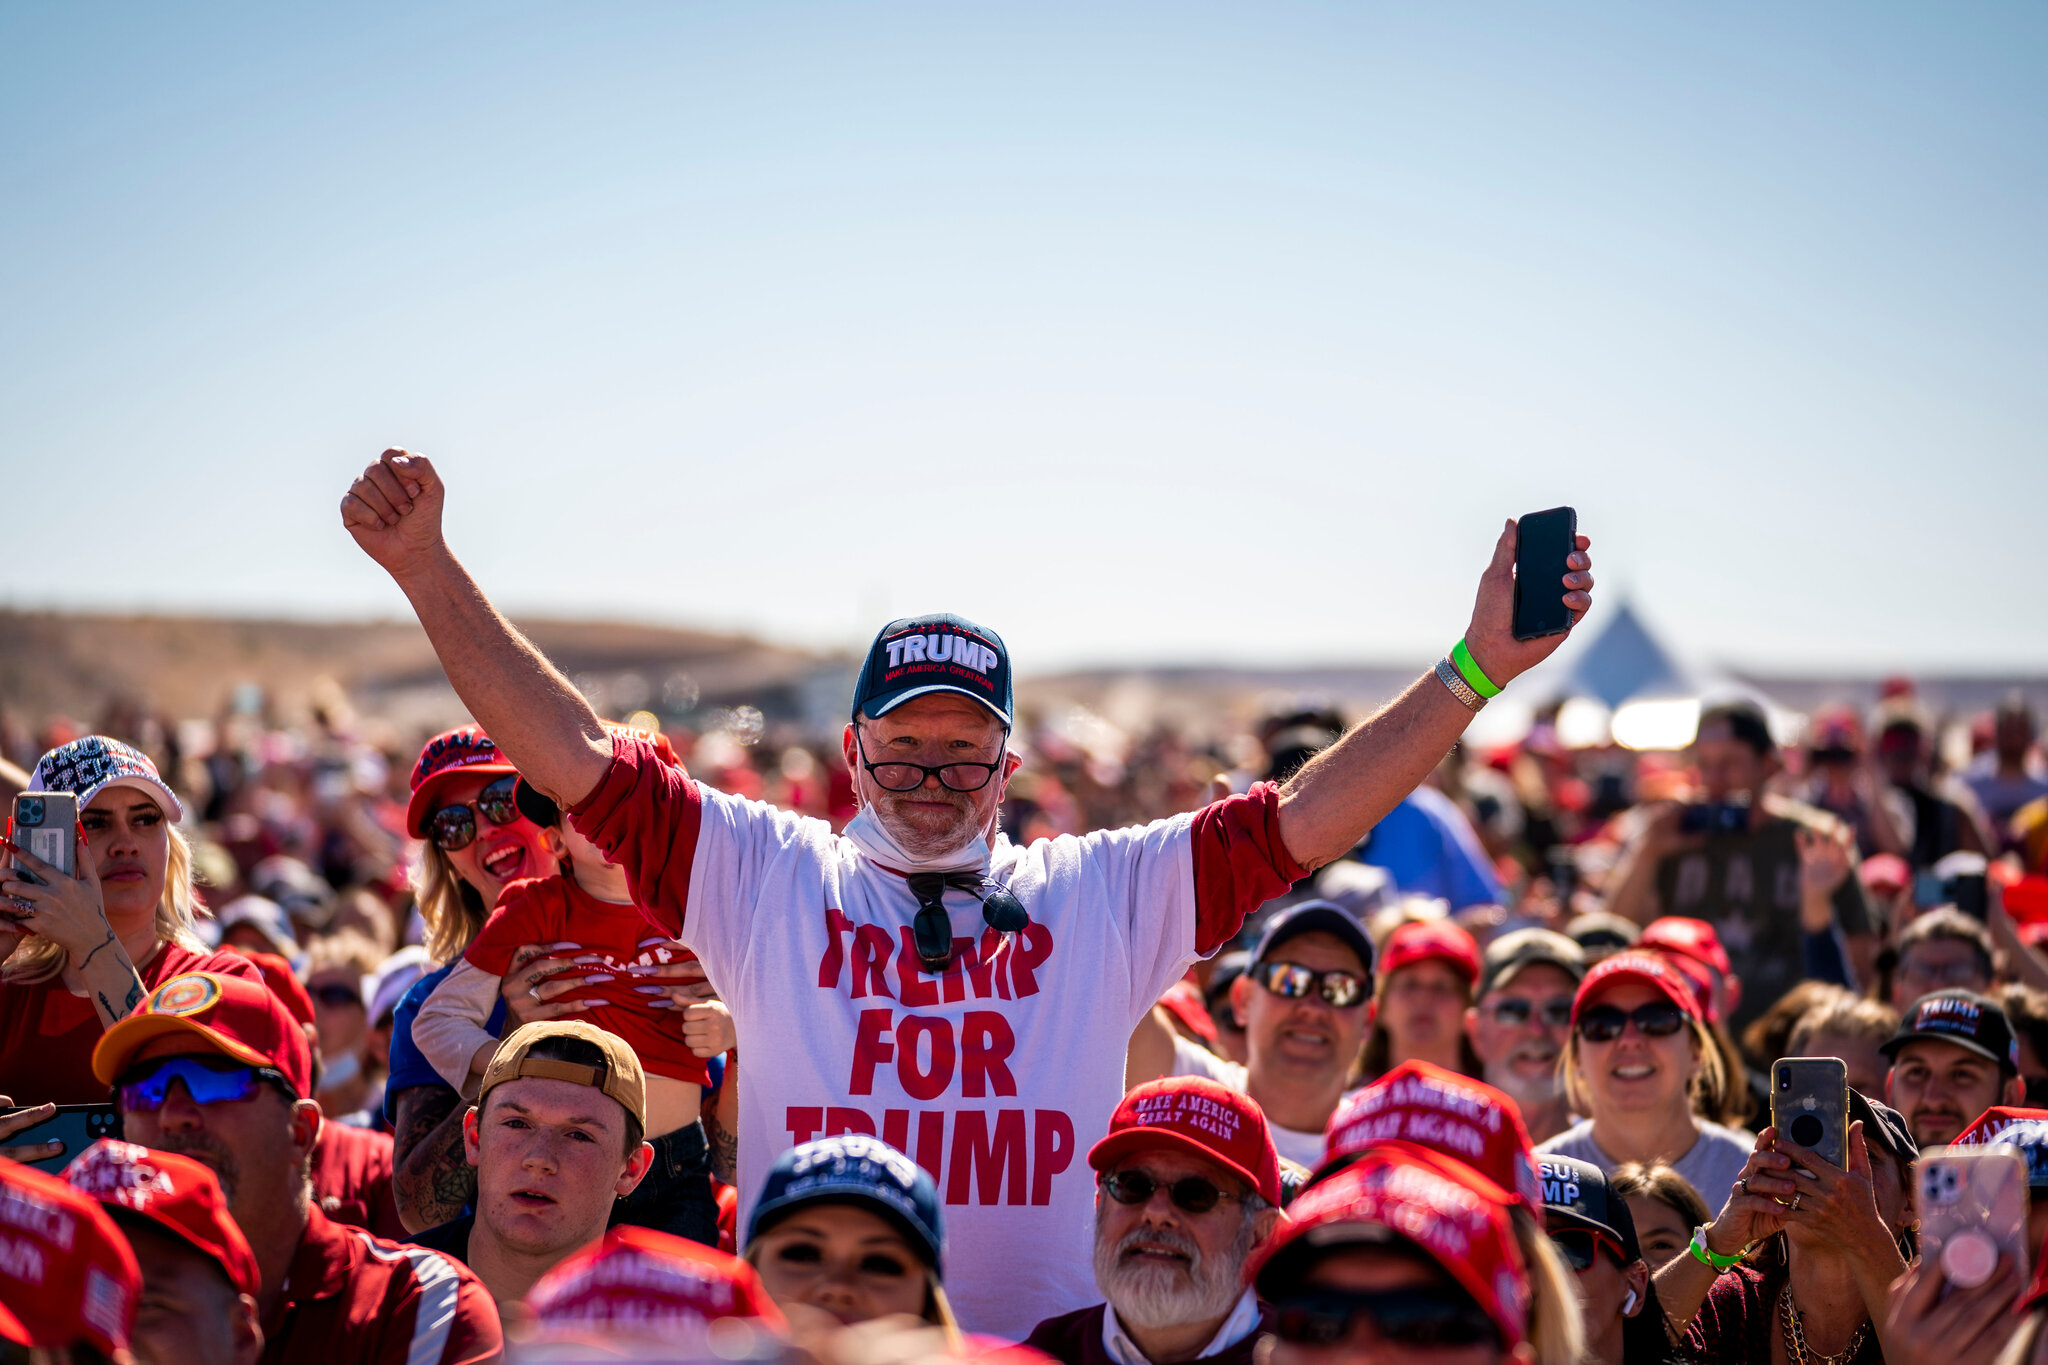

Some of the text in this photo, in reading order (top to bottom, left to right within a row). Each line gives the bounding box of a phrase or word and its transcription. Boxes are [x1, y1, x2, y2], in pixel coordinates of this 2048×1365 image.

[886, 633, 998, 675] TRUMP
[885, 667, 906, 683] MAKE
[906, 664, 947, 675] AMERICA
[949, 665, 976, 680] GREAT
[1921, 998, 1980, 1019] TRUMP
[849, 1009, 1017, 1101] FOR
[1135, 1092, 1240, 1130] MAKE AMERICA
[1137, 1111, 1232, 1141] GREAT AGAIN
